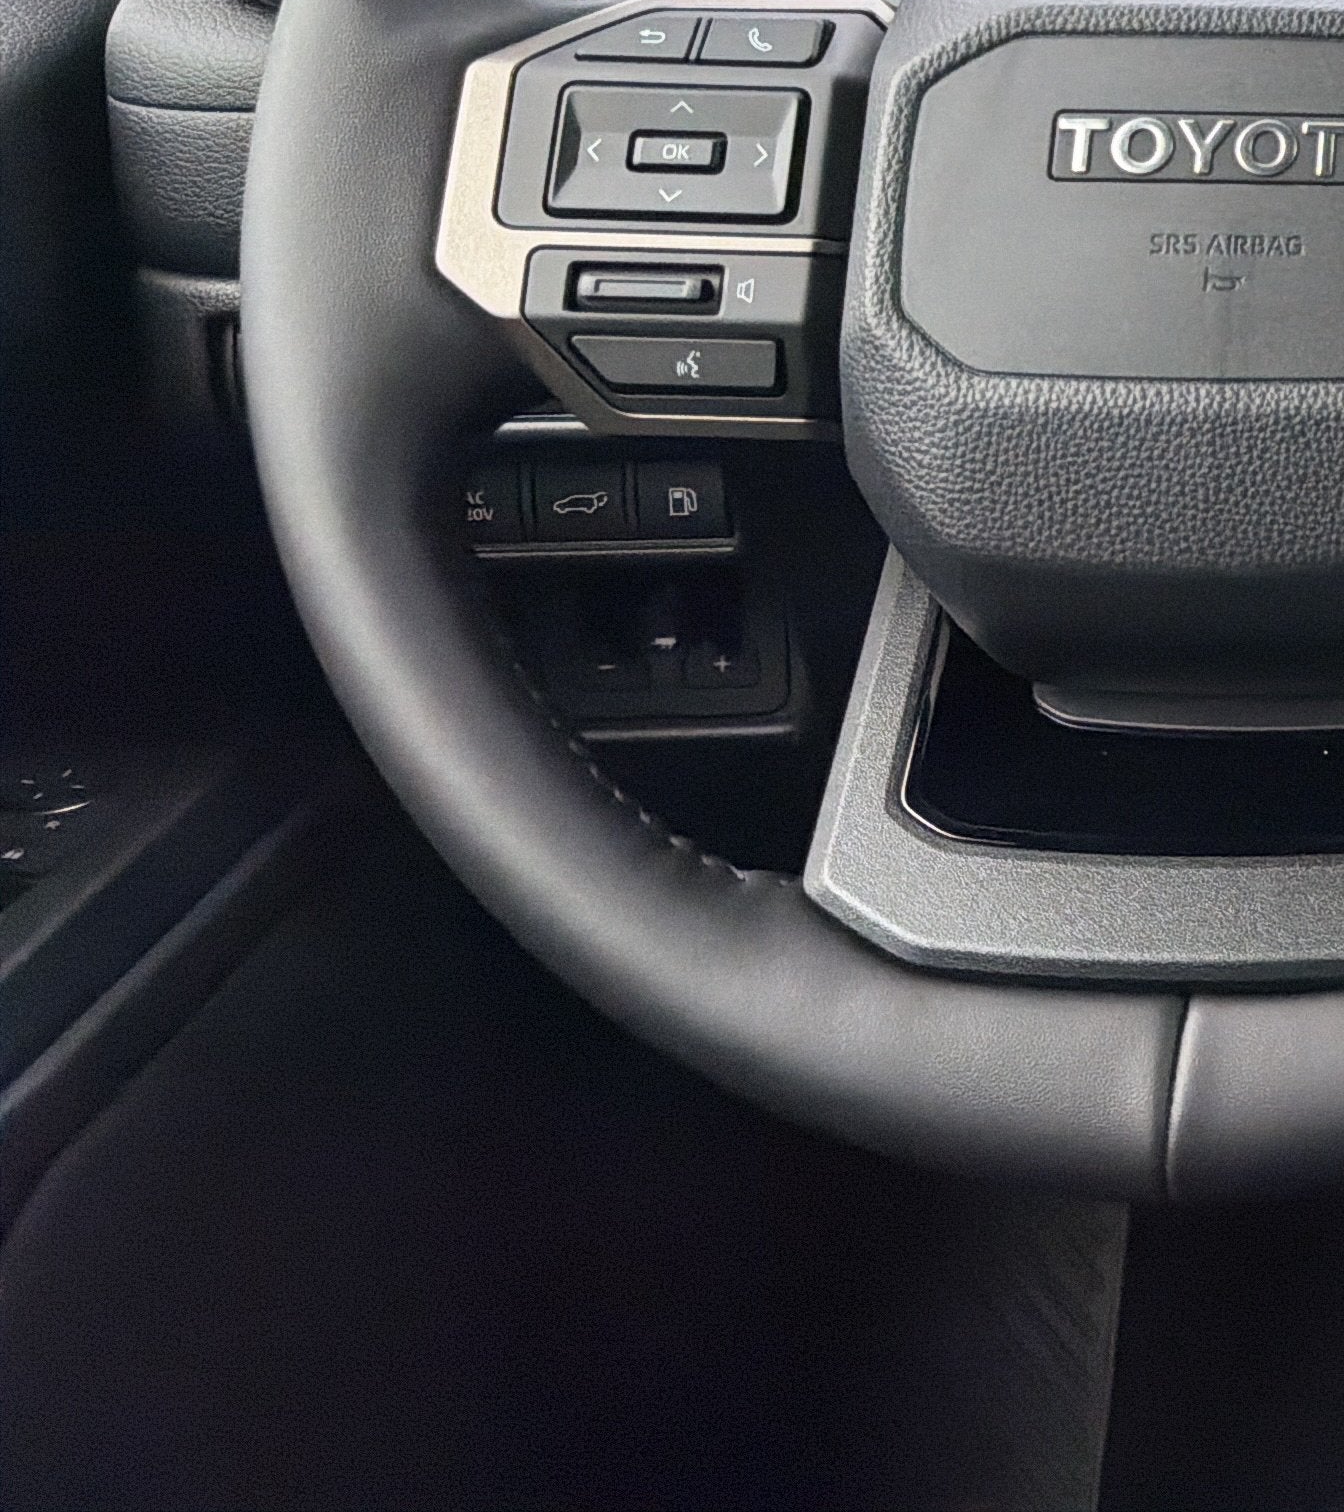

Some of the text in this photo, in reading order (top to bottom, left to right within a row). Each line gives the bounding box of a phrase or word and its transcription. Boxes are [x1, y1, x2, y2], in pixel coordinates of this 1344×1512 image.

[662, 144, 689, 160] OK
[1149, 234, 1303, 256] SRS AIRBAG
